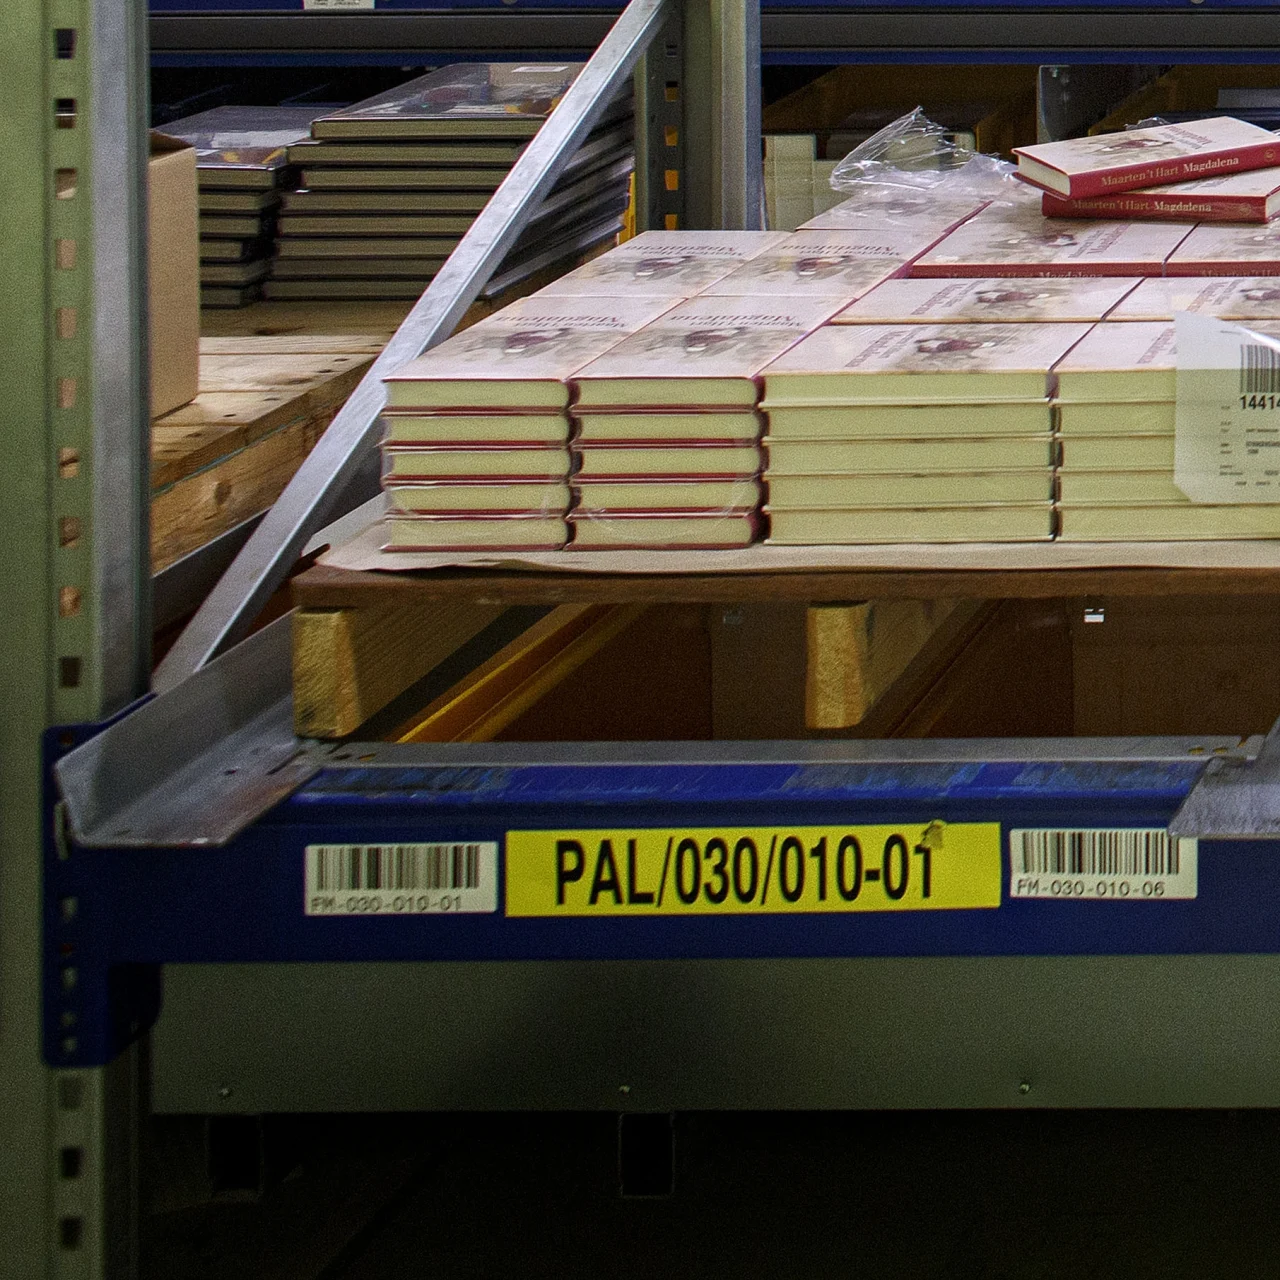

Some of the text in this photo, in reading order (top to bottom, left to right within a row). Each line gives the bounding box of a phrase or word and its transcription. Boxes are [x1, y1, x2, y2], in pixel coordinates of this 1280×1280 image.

[1101, 172, 1146, 187] Maarten
[1155, 166, 1179, 178] Hart
[1183, 156, 1239, 175] Magdalena
[1071, 199, 1116, 210] Maarten
[1125, 200, 1150, 211] Hart
[1153, 202, 1212, 214] Magdalena
[555, 833, 932, 908] PAL/030/010-01
[1016, 879, 1166, 897] FM-030-010-06
[310, 894, 463, 913] FM-030-010-01
